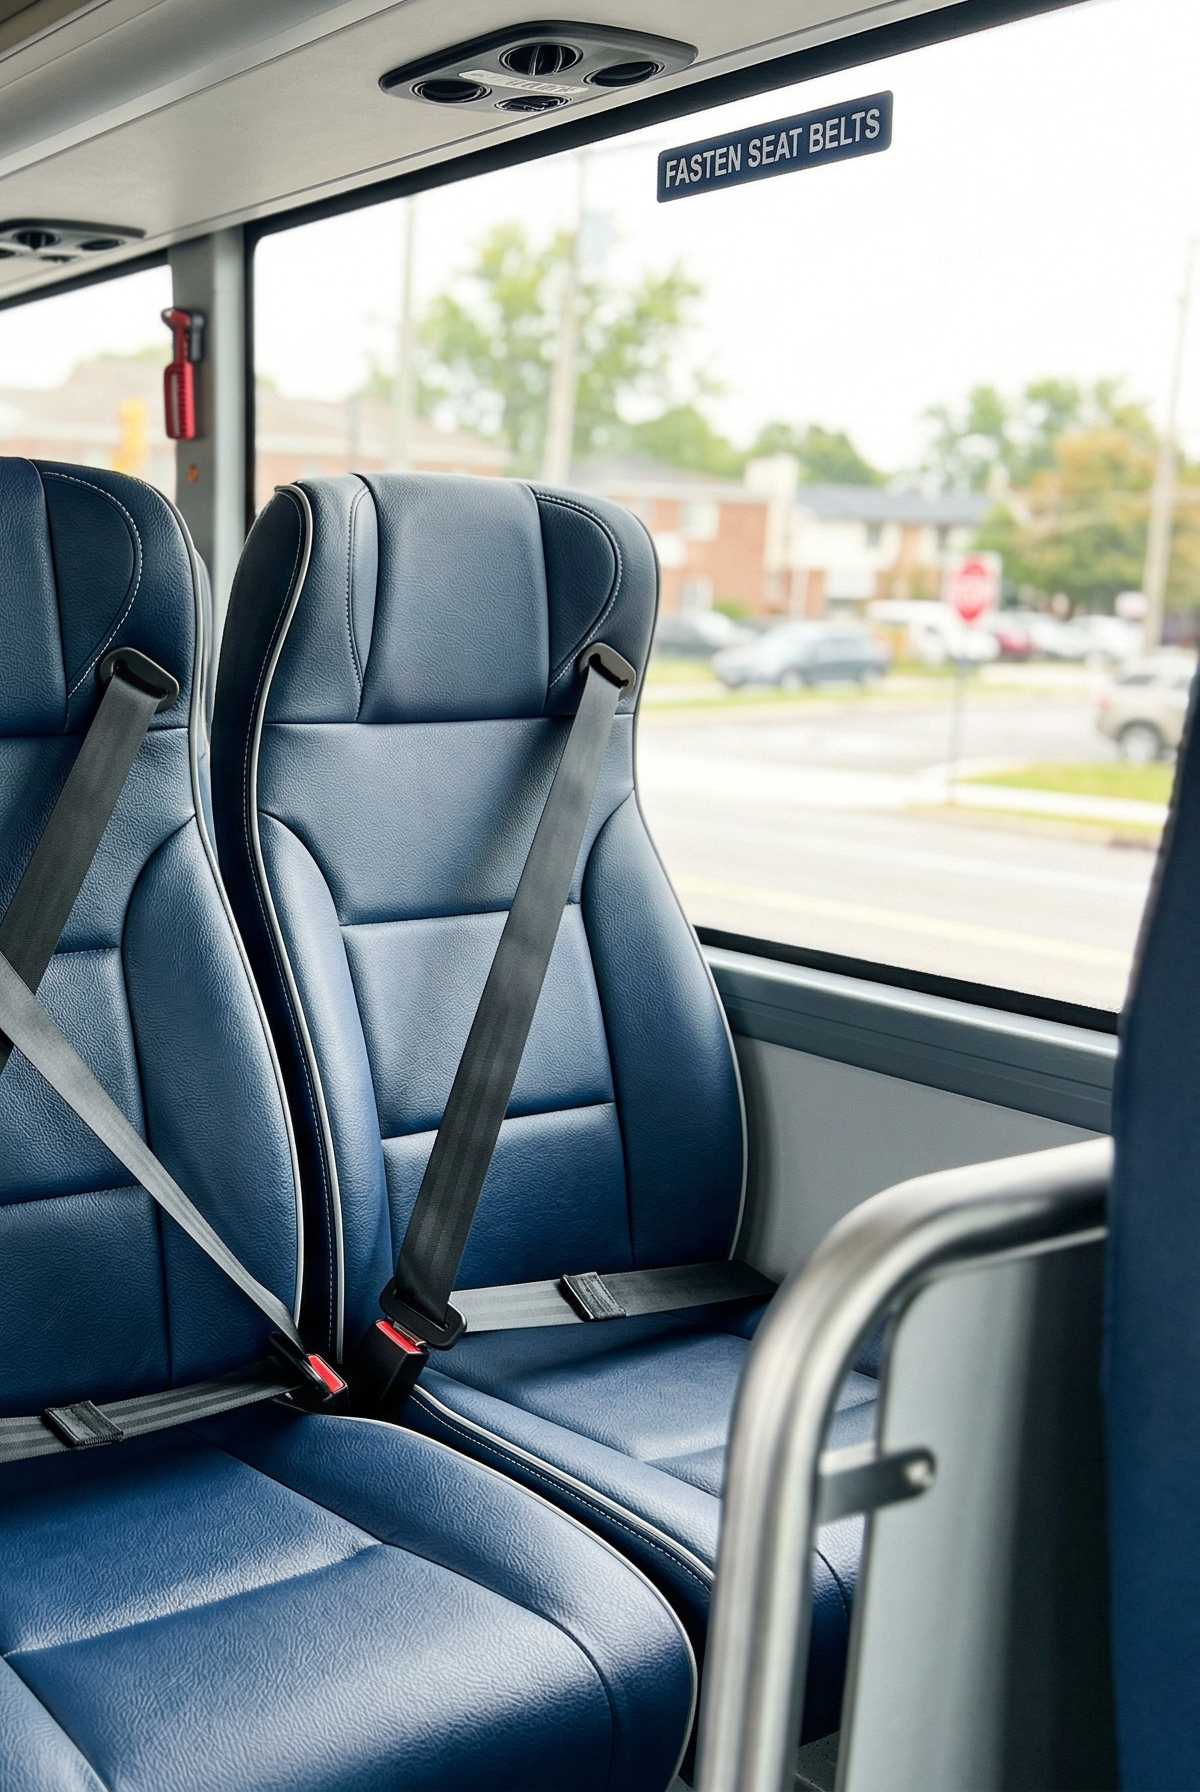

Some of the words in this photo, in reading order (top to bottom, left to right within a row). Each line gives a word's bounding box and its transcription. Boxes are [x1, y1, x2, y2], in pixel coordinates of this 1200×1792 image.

[665, 143, 742, 188] FASTEN
[748, 127, 803, 168] SEAT
[809, 108, 881, 153] BELTS
